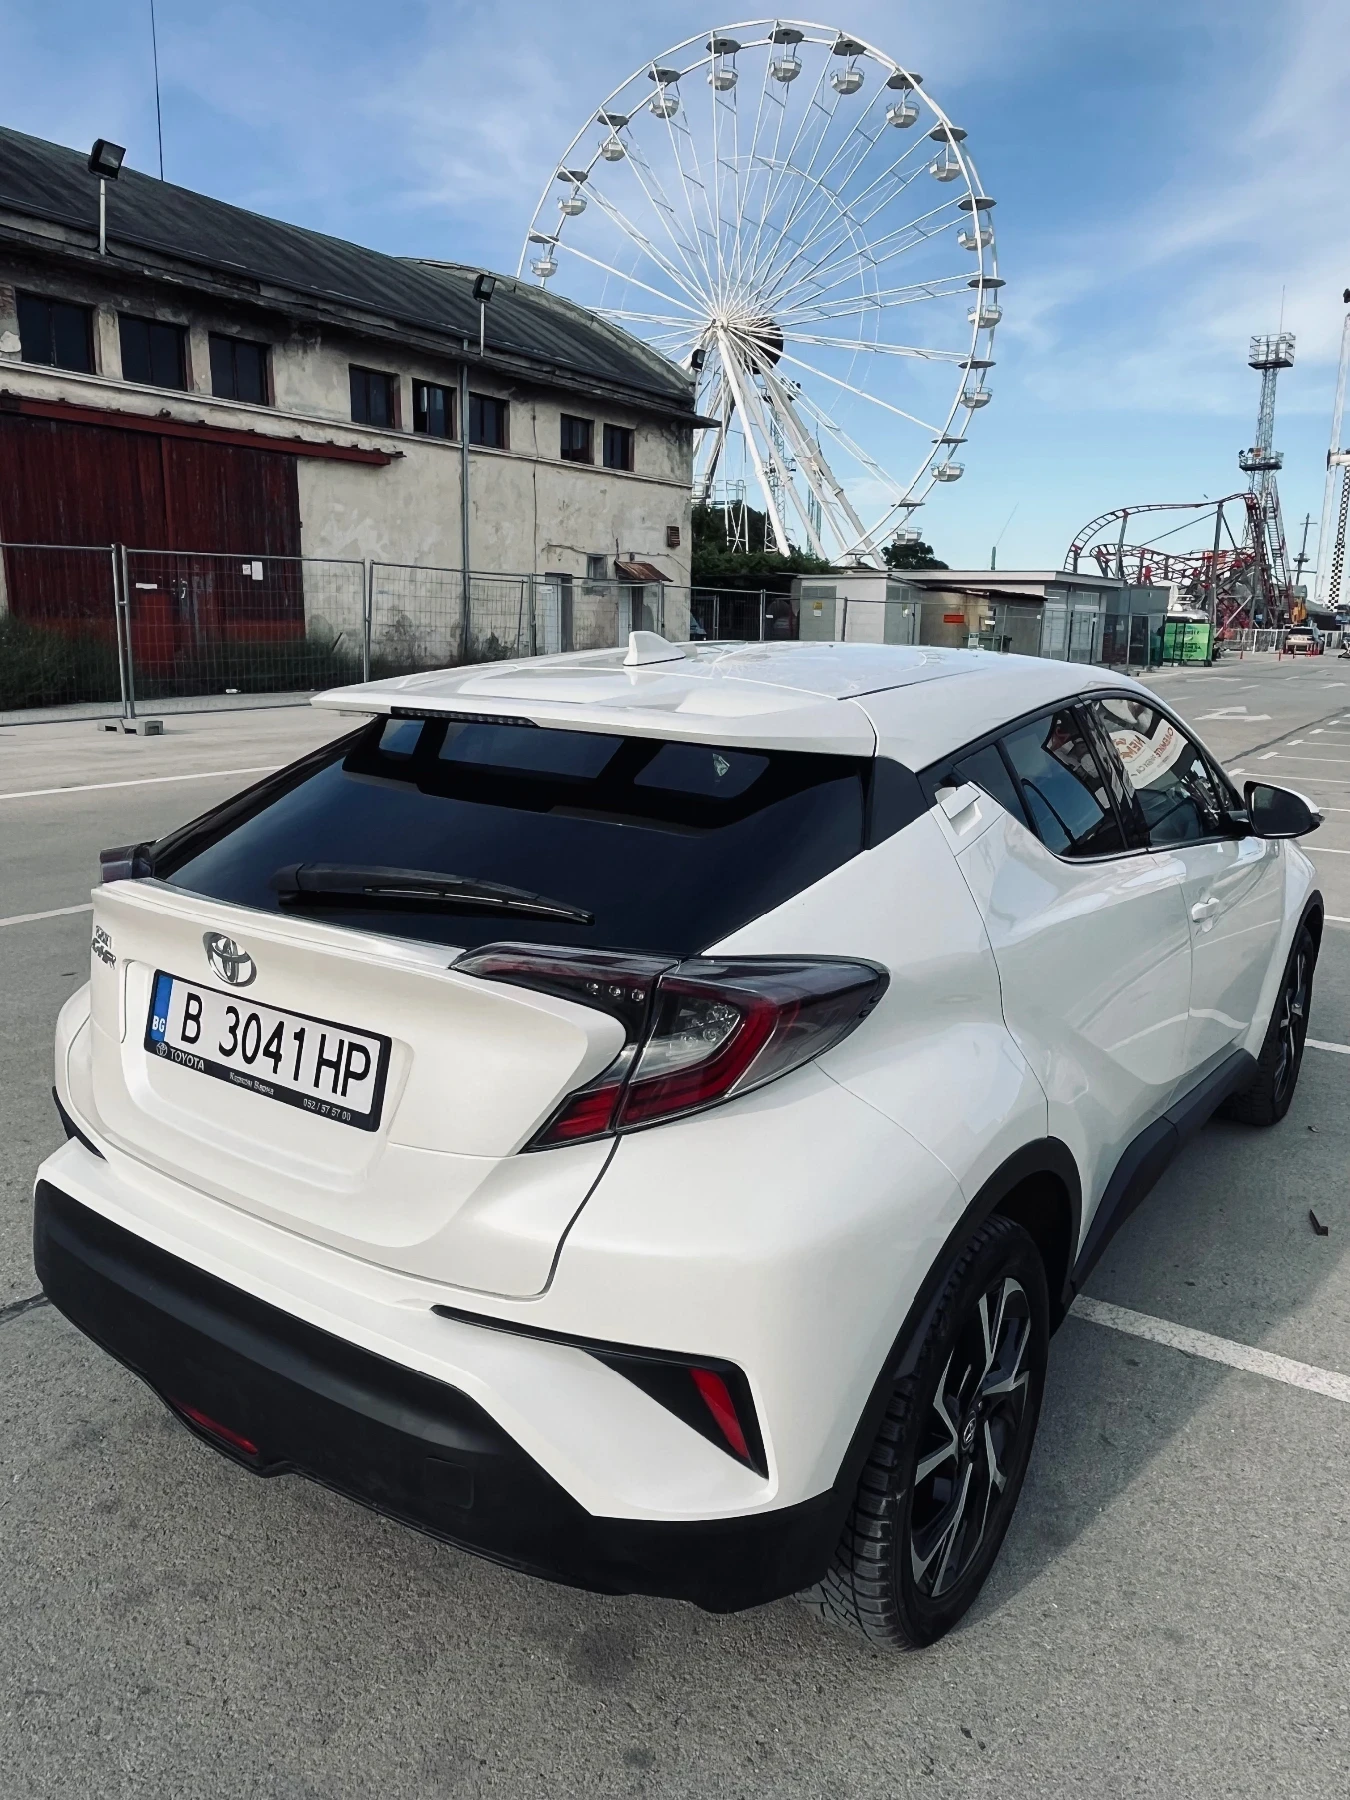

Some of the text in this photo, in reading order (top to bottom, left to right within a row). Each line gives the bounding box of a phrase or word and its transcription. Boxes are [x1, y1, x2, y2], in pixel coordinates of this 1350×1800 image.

[152, 1015, 166, 1032] BG
[181, 992, 203, 1045] B
[169, 1048, 205, 1071] TOYOTA
